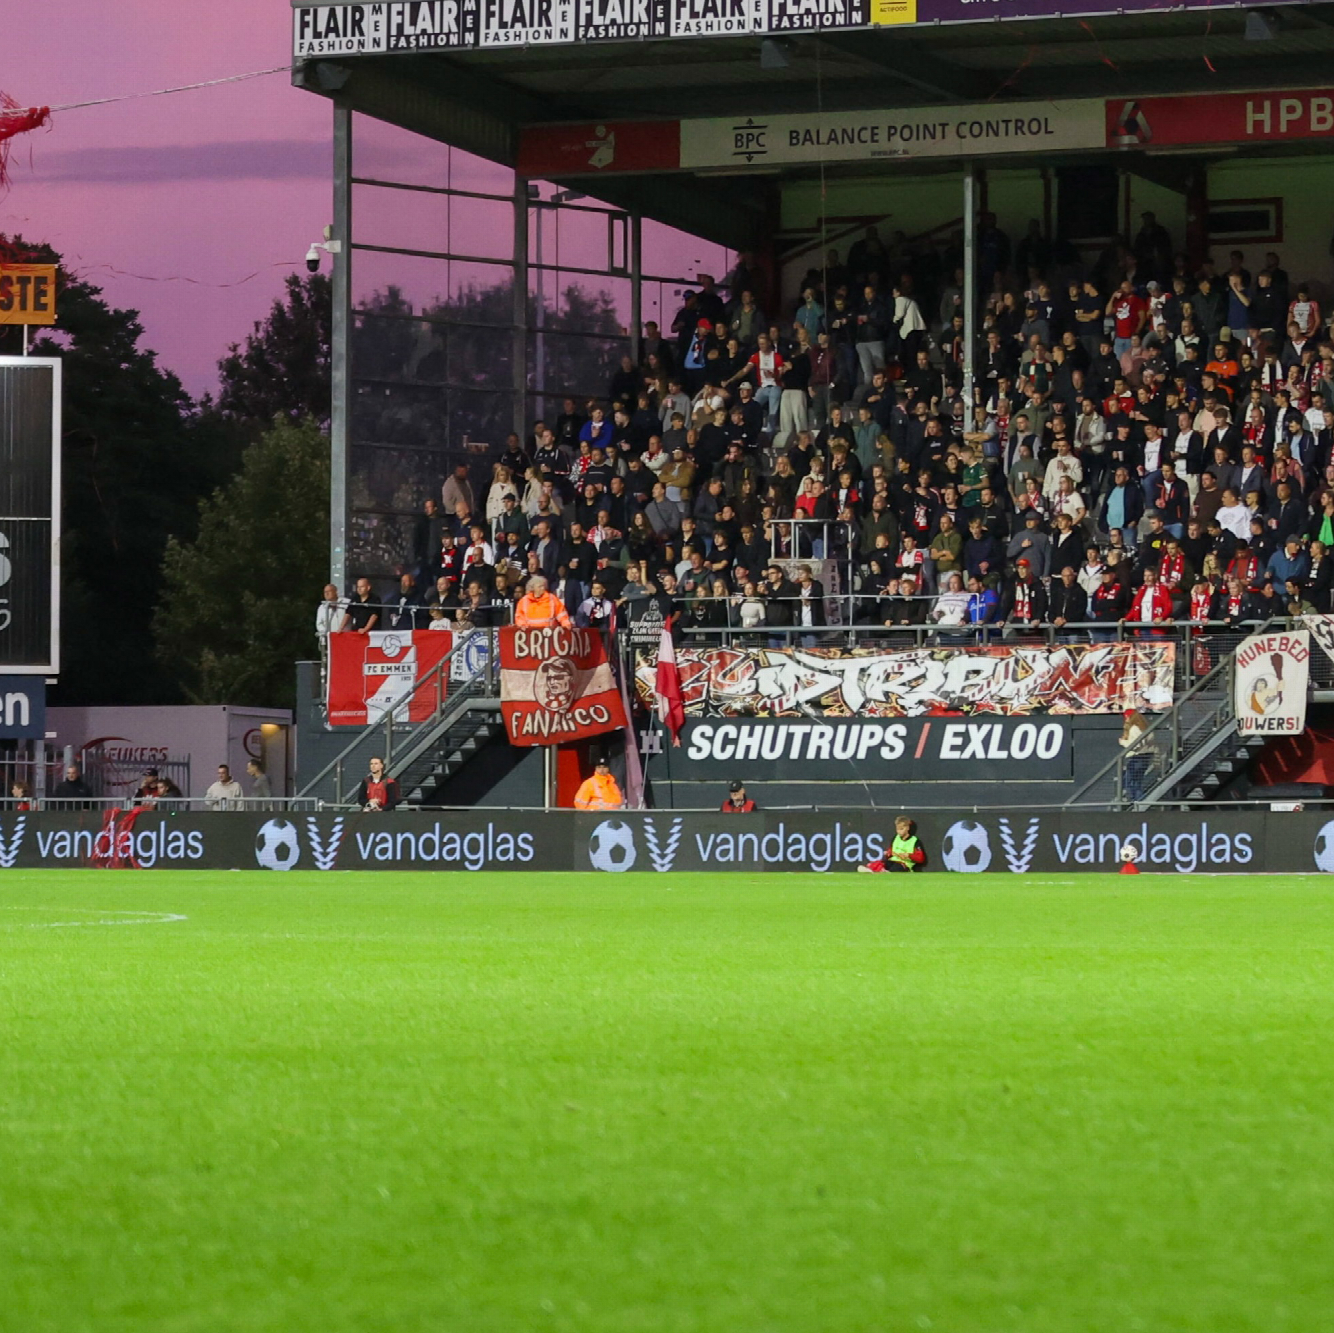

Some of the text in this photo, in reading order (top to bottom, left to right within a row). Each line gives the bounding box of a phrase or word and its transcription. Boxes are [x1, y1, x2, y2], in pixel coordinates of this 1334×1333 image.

[299, 5, 366, 40] FLAIR
[390, 1, 459, 35] FLAIR
[578, 23, 649, 40] FASHION
[674, 18, 746, 35] FASHION
[772, 12, 845, 30] FASHION
[298, 40, 366, 53] FASHION
[390, 33, 460, 48] FASHION
[484, 29, 553, 44] FASHION
[734, 116, 1054, 150] BPC BALANCE POINT CONTROL
[1247, 98, 1334, 134] HPB
[368, 665, 412, 673] FC EMMEN
[1236, 636, 1310, 668] HUNEBED
[688, 725, 907, 760] SCHUTRUPS
[939, 722, 1064, 760] EXLOO
[36, 820, 204, 868] vandaglas
[356, 822, 535, 871] vandaglas
[695, 821, 885, 872] vandaglas
[1054, 821, 1253, 874] vandaglas
